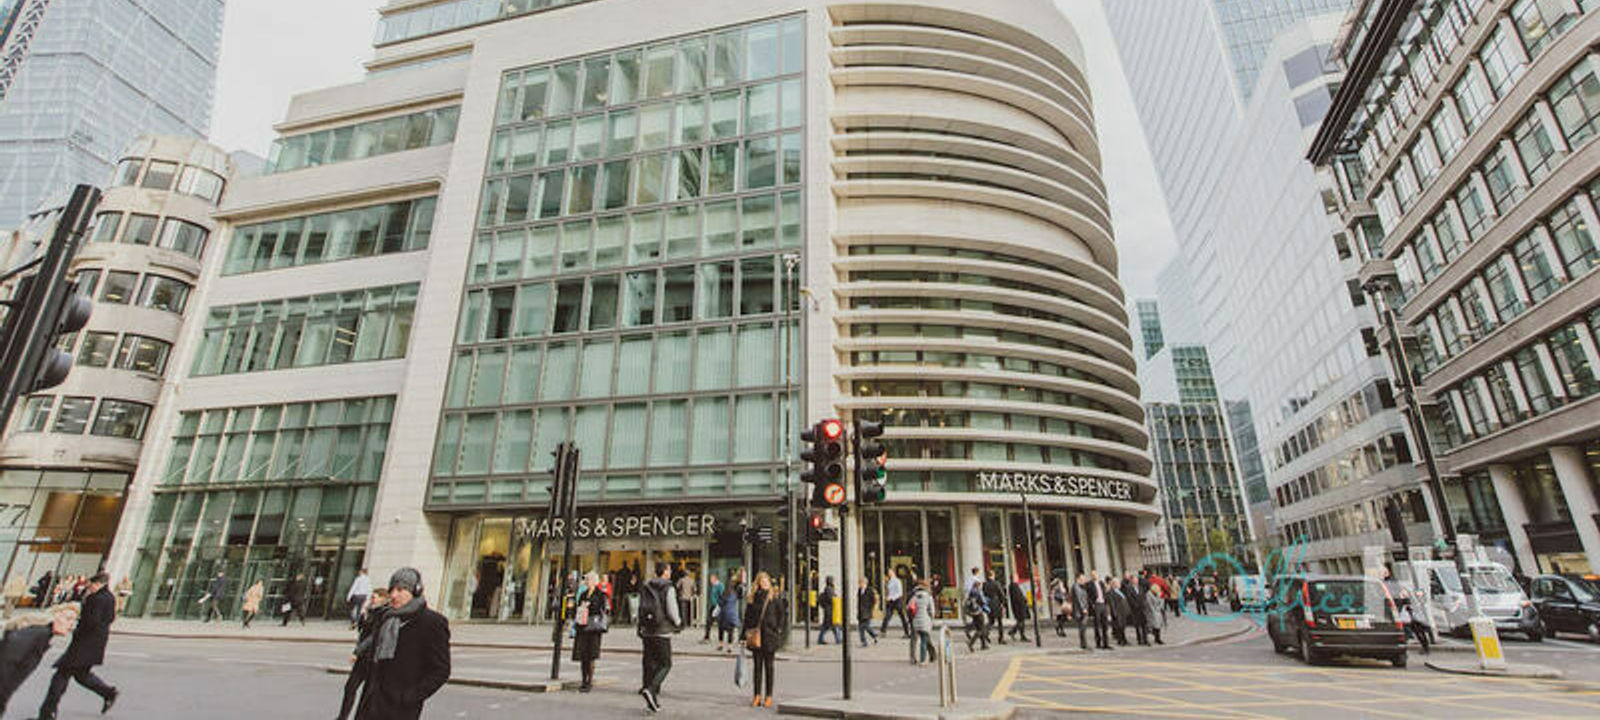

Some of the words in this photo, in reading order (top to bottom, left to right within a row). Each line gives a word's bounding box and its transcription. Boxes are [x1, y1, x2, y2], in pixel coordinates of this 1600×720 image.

[978, 471, 1051, 493] MARKS
[1067, 475, 1132, 500] SPENCER
[593, 517, 607, 537] &
[611, 513, 715, 537] SPENCER
